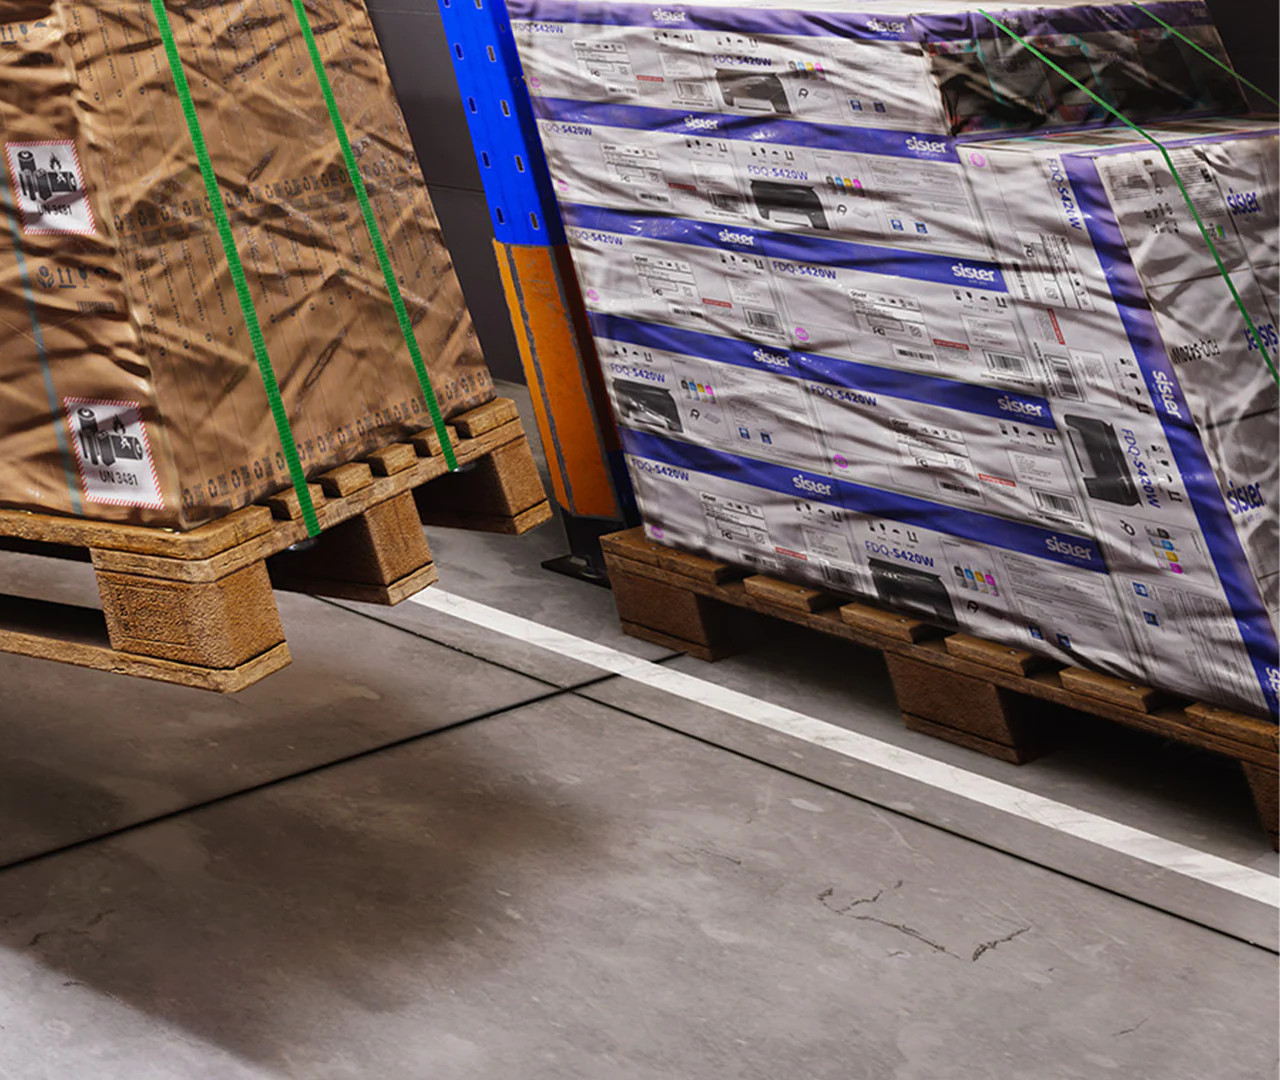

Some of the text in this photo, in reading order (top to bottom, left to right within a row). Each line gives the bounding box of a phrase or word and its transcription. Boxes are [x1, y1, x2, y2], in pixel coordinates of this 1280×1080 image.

[653, 7, 687, 24] sister
[866, 17, 907, 35] sister
[684, 115, 720, 131] sister
[905, 136, 947, 153] sister
[51, 204, 73, 216] 3481
[1226, 188, 1261, 216] sister
[718, 228, 755, 246] sister
[772, 261, 837, 280] FDQ-S420W
[951, 262, 997, 283] sister
[752, 348, 791, 369] sister
[810, 384, 878, 408] FDQ-S420W
[1152, 370, 1183, 420] sister
[997, 395, 1043, 419] sister
[100, 471, 139, 485] UN 3481
[1121, 428, 1161, 509] FDQ-S420W
[792, 475, 832, 497] sister
[1227, 482, 1265, 516] sister
[865, 540, 935, 568] FDQ-S420W
[1045, 536, 1093, 561] sister
